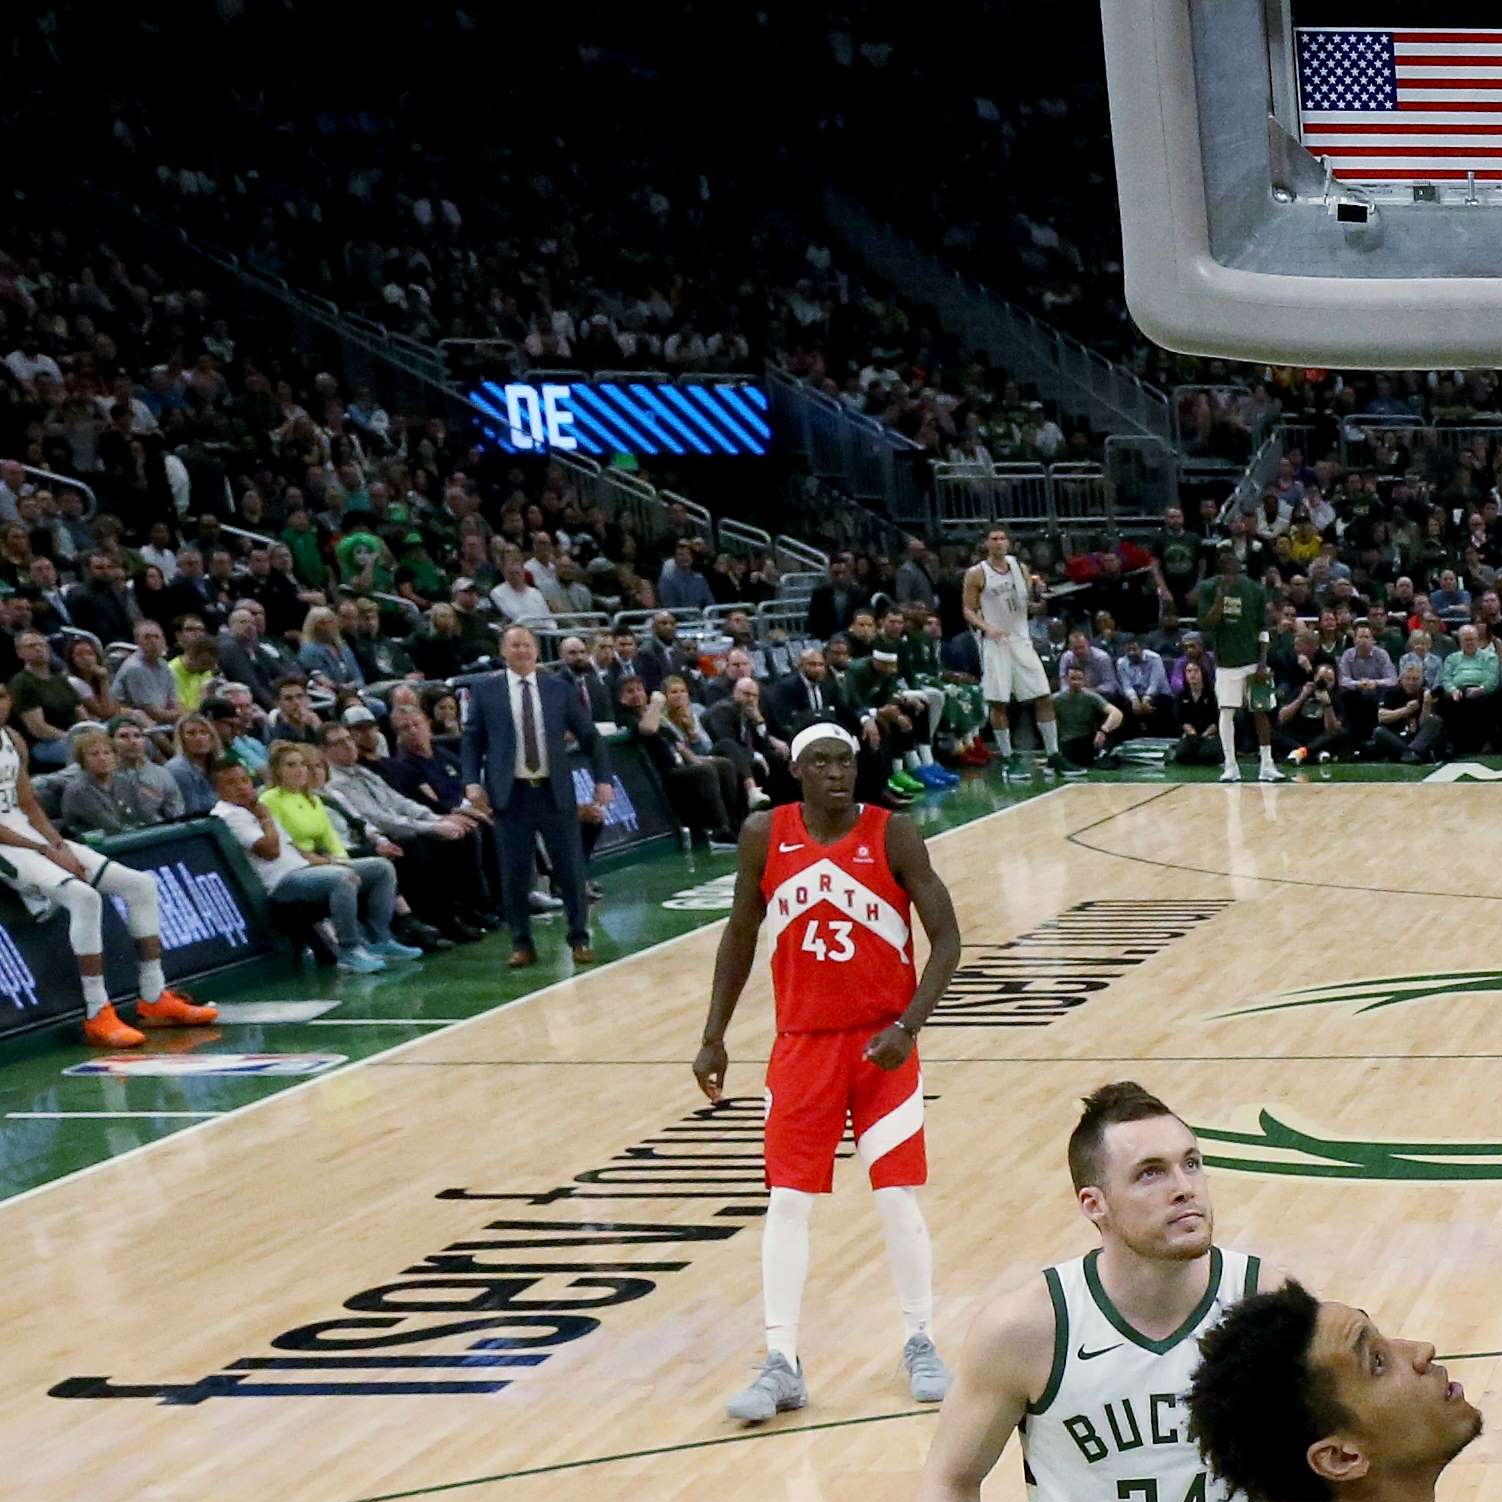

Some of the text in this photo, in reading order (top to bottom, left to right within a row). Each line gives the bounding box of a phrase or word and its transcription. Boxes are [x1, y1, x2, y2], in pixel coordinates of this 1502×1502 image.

[505, 384, 577, 450] DE
[776, 872, 882, 923] NORTH
[801, 918, 856, 962] 43
[1062, 1392, 1199, 1465] BUC
